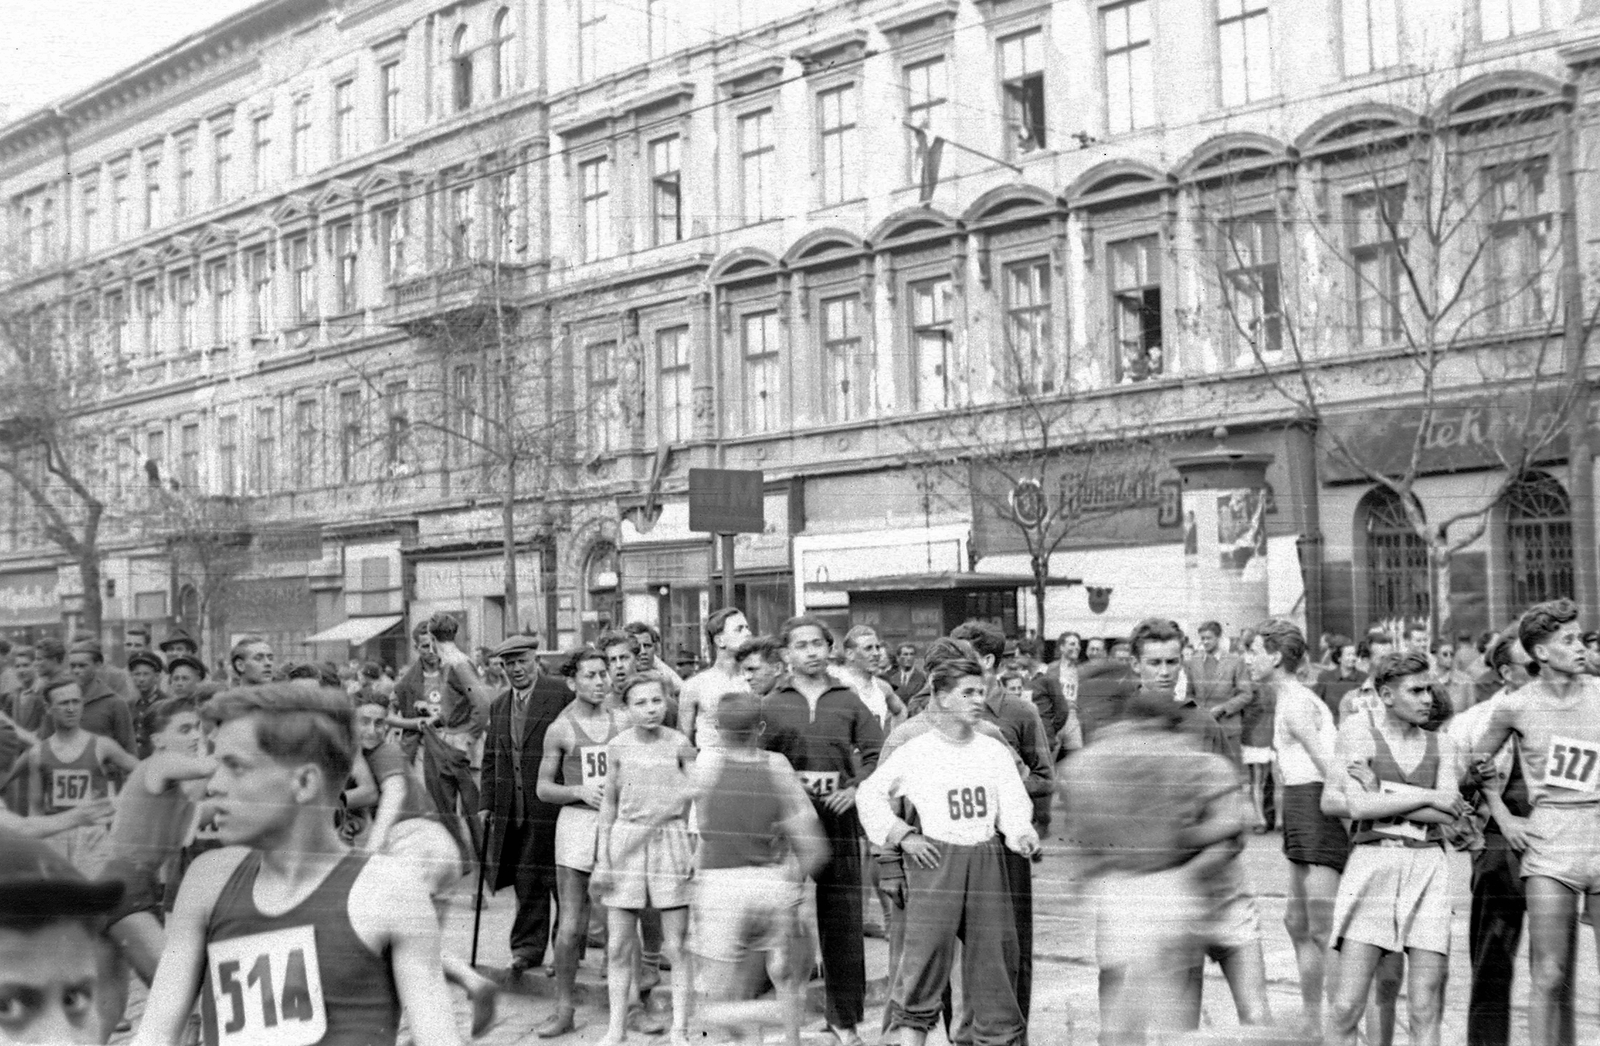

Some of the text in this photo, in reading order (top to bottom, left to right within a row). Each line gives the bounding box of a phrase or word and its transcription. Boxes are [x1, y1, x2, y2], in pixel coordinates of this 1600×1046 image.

[1550, 744, 1598, 782] 527
[56, 774, 89, 800] 567
[948, 785, 988, 820] 689
[218, 948, 314, 1034] 514
